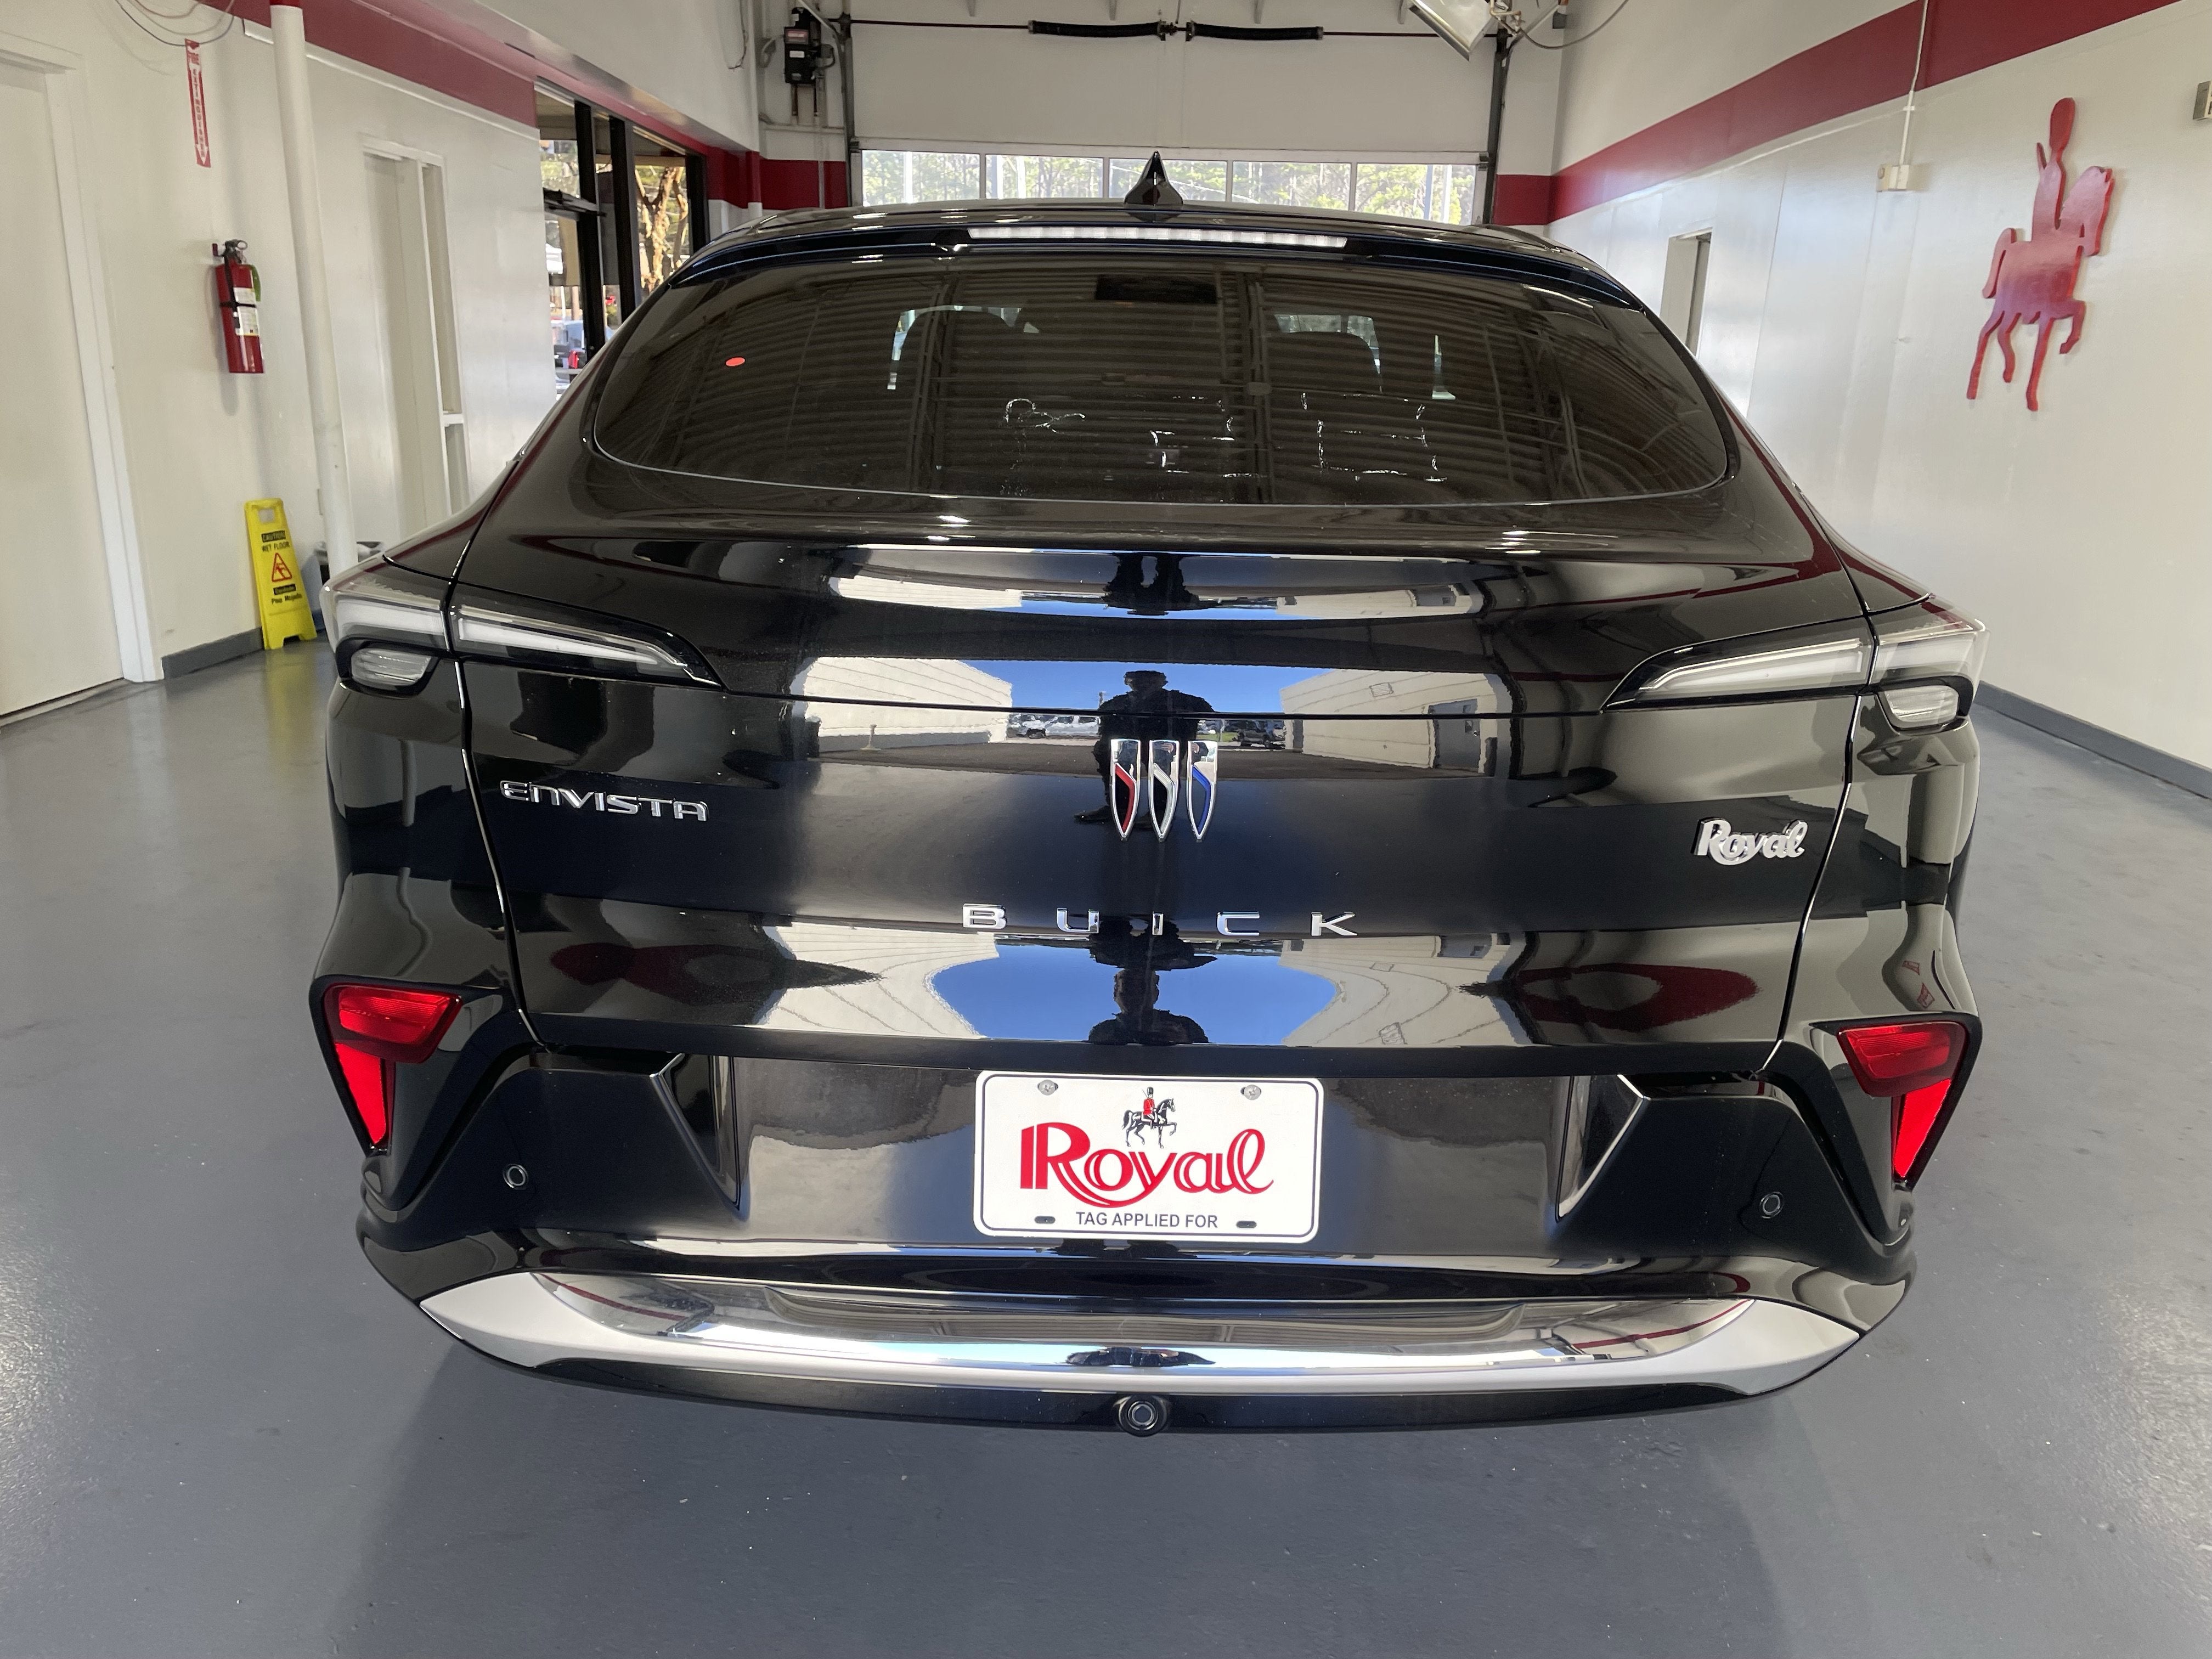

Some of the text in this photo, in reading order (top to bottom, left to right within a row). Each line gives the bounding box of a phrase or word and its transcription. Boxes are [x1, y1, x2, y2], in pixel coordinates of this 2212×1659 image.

[500, 780, 708, 821] ENVISTA
[1692, 817, 1808, 865] Royal
[963, 903, 1358, 936] BUICK
[1020, 1122, 1274, 1208] Royal
[1076, 1211, 1218, 1228] TAG APPLIED FOR
